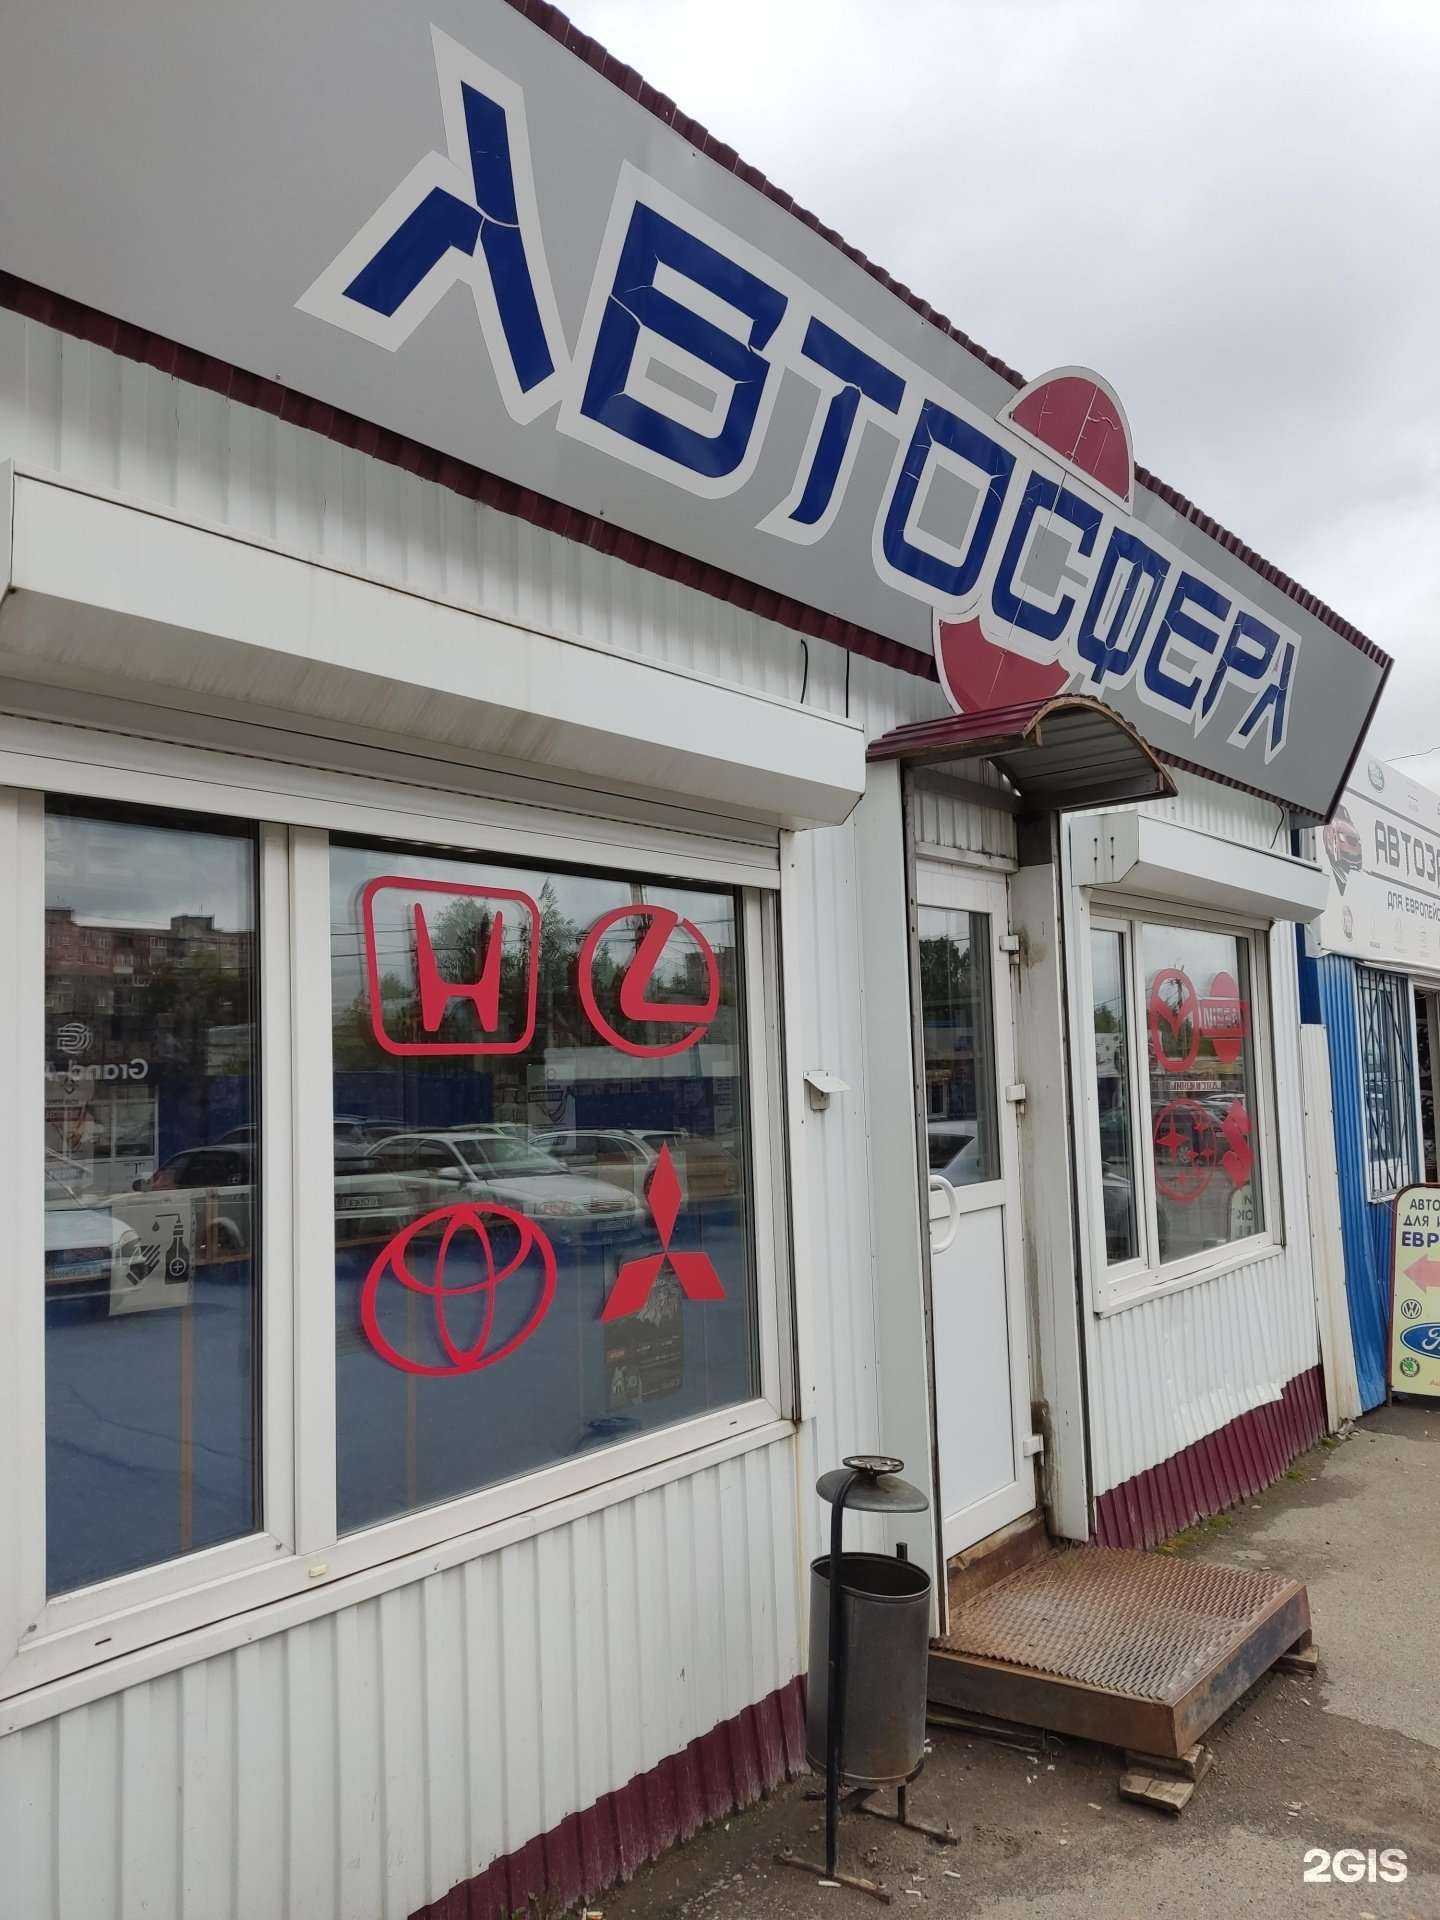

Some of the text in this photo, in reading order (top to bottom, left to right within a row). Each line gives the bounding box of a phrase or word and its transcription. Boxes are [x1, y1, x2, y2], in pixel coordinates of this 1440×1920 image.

[340, 78, 1302, 748] АВТОСФЕРА
[1403, 1215, 1429, 1227] ДЛЯ
[1402, 1231, 1440, 1248] ЕВР
